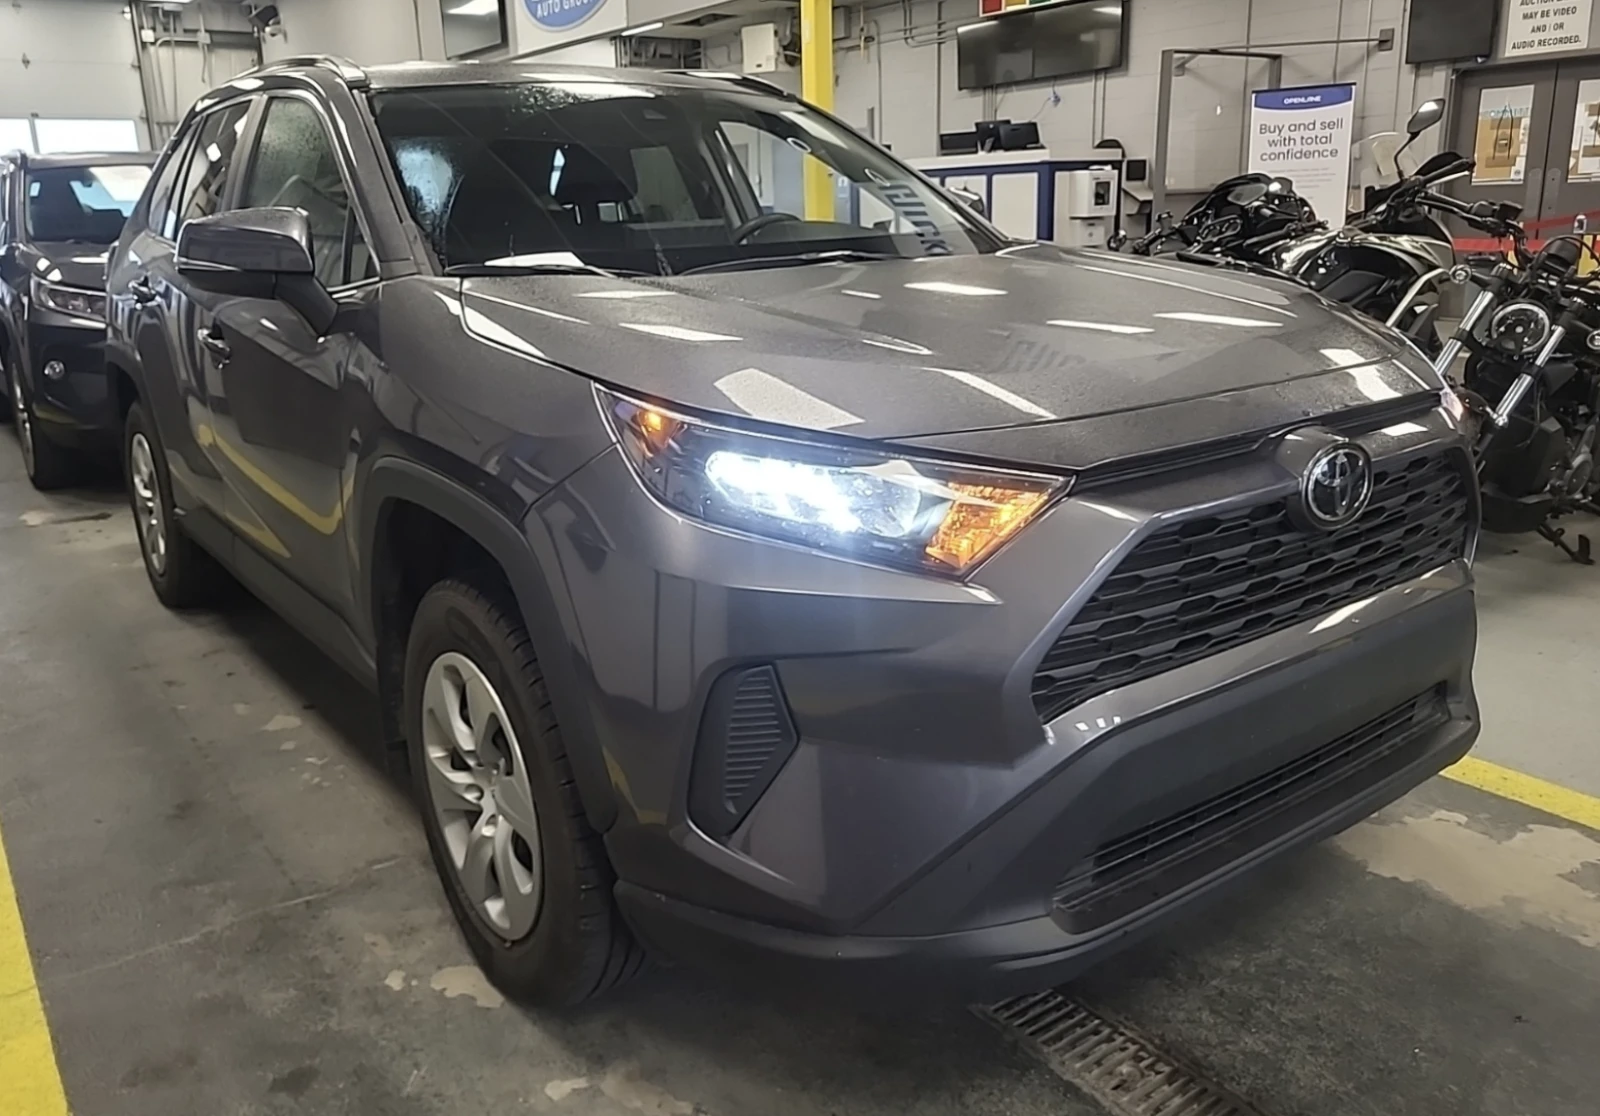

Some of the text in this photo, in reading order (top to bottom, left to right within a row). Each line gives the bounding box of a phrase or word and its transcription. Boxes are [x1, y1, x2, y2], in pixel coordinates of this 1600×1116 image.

[536, 0, 560, 19] AUTO
[1522, 6, 1577, 20] MAY BE VIDEO
[1530, 24, 1547, 34] AND
[1553, 22, 1565, 31] OR
[1511, 35, 1581, 50] AUDIO RECORDED.
[1259, 117, 1343, 136] Buy and sell
[1267, 133, 1332, 147] with total
[1260, 148, 1339, 161] confidence
